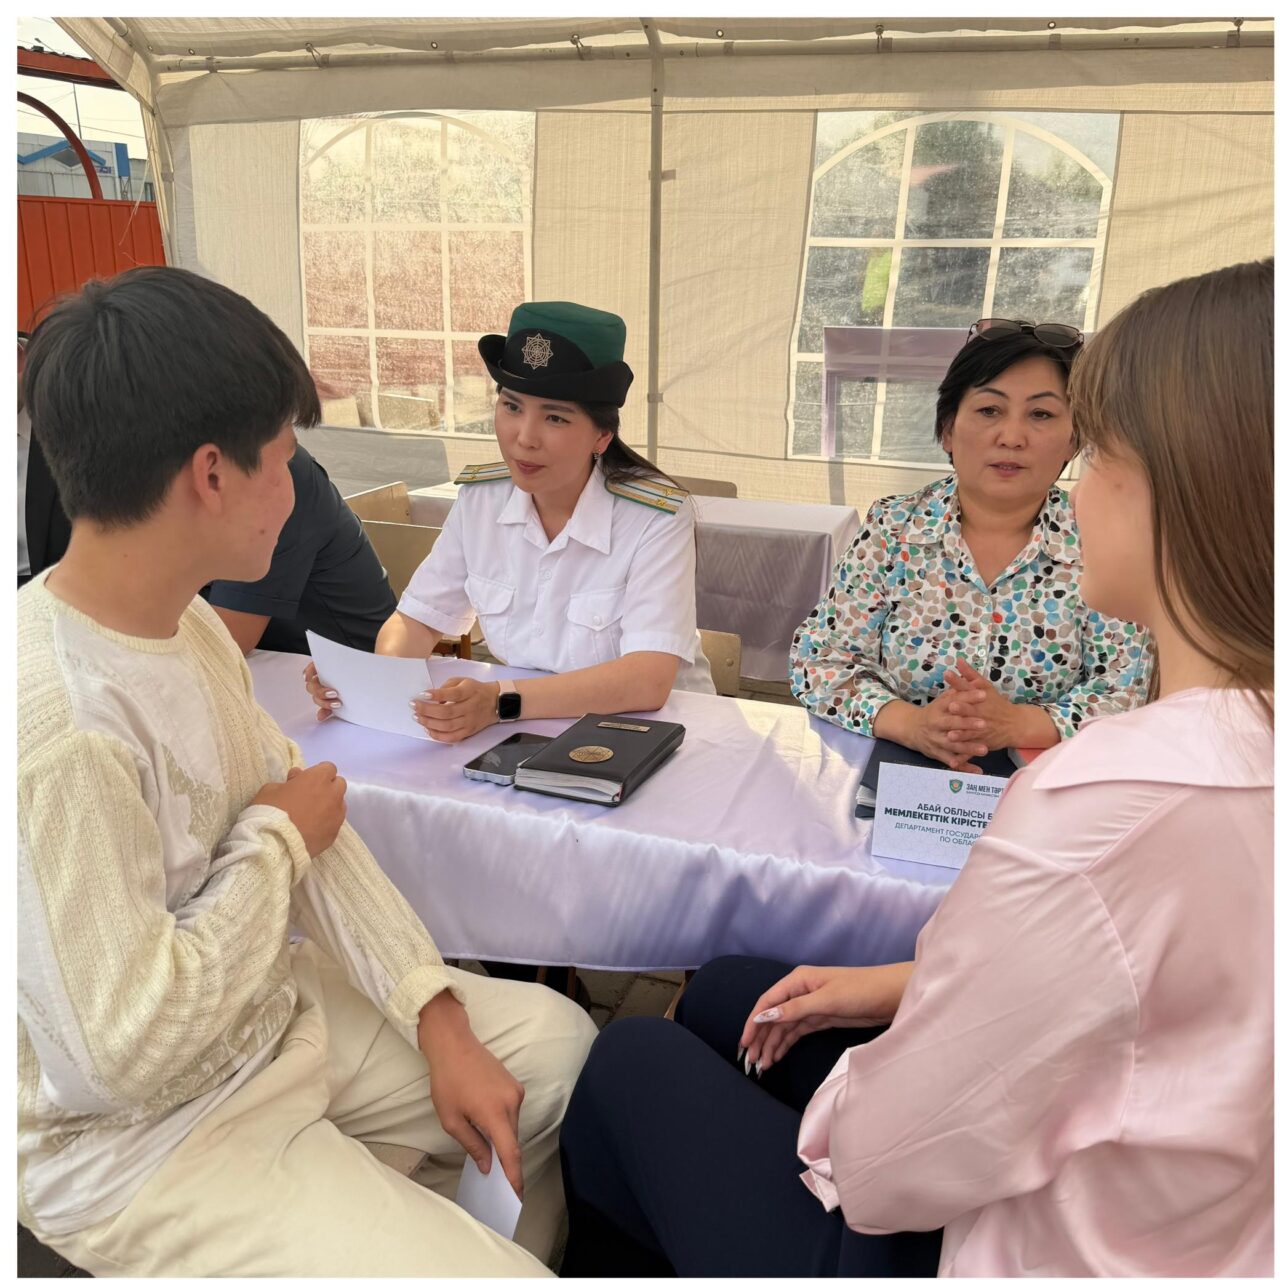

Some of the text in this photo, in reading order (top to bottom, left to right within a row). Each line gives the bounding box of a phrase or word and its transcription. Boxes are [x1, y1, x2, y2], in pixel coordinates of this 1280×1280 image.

[884, 807, 949, 824] МЕМЛЕКЕТТІК
[917, 802, 941, 813] АБАЙ
[943, 806, 986, 819] ОБЛЫСЫ
[894, 822, 944, 835] ДЕПАРТАМЕНТ
[940, 835, 951, 843] ПО
